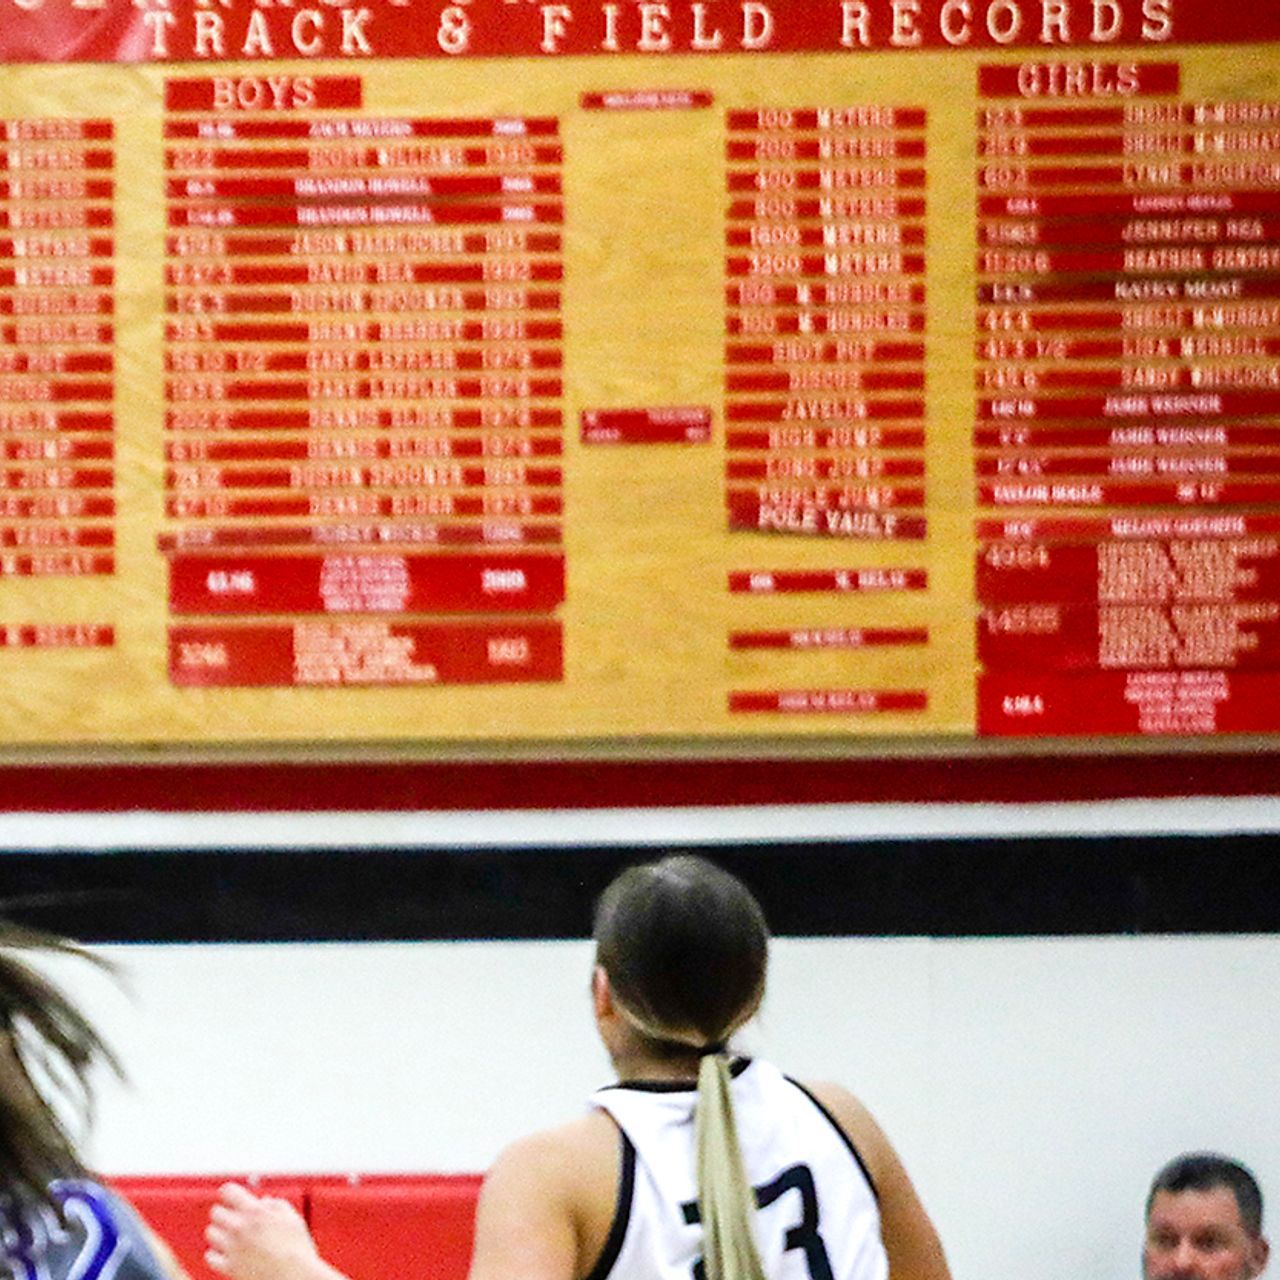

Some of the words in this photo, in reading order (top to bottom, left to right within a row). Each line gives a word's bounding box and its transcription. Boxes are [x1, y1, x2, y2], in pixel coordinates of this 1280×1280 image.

[144, 8, 373, 57] TRACK
[438, 7, 470, 53] &
[540, 2, 774, 53] FIELD
[840, 0, 1173, 47] RECORDS
[1017, 62, 1141, 97] GIRLS
[213, 76, 316, 109] BOYS
[758, 108, 793, 128] 100
[817, 108, 894, 128] METERS
[756, 138, 795, 157] 200
[819, 138, 895, 157] METERS
[755, 168, 795, 188] 400
[819, 168, 895, 188] METERS
[819, 198, 897, 217] METERS
[822, 226, 900, 246] METERS
[823, 254, 901, 275] METERS
[836, 341, 874, 361] PUT
[788, 371, 862, 390] DISCUS
[781, 399, 867, 420] JAVELIN
[768, 427, 816, 448] HIGH
[826, 427, 882, 448] JUMP
[766, 458, 815, 478] LONG
[827, 458, 883, 478] JUMP
[838, 486, 894, 507] JUMP
[758, 504, 817, 528] POLE
[825, 509, 898, 537] VAULT
